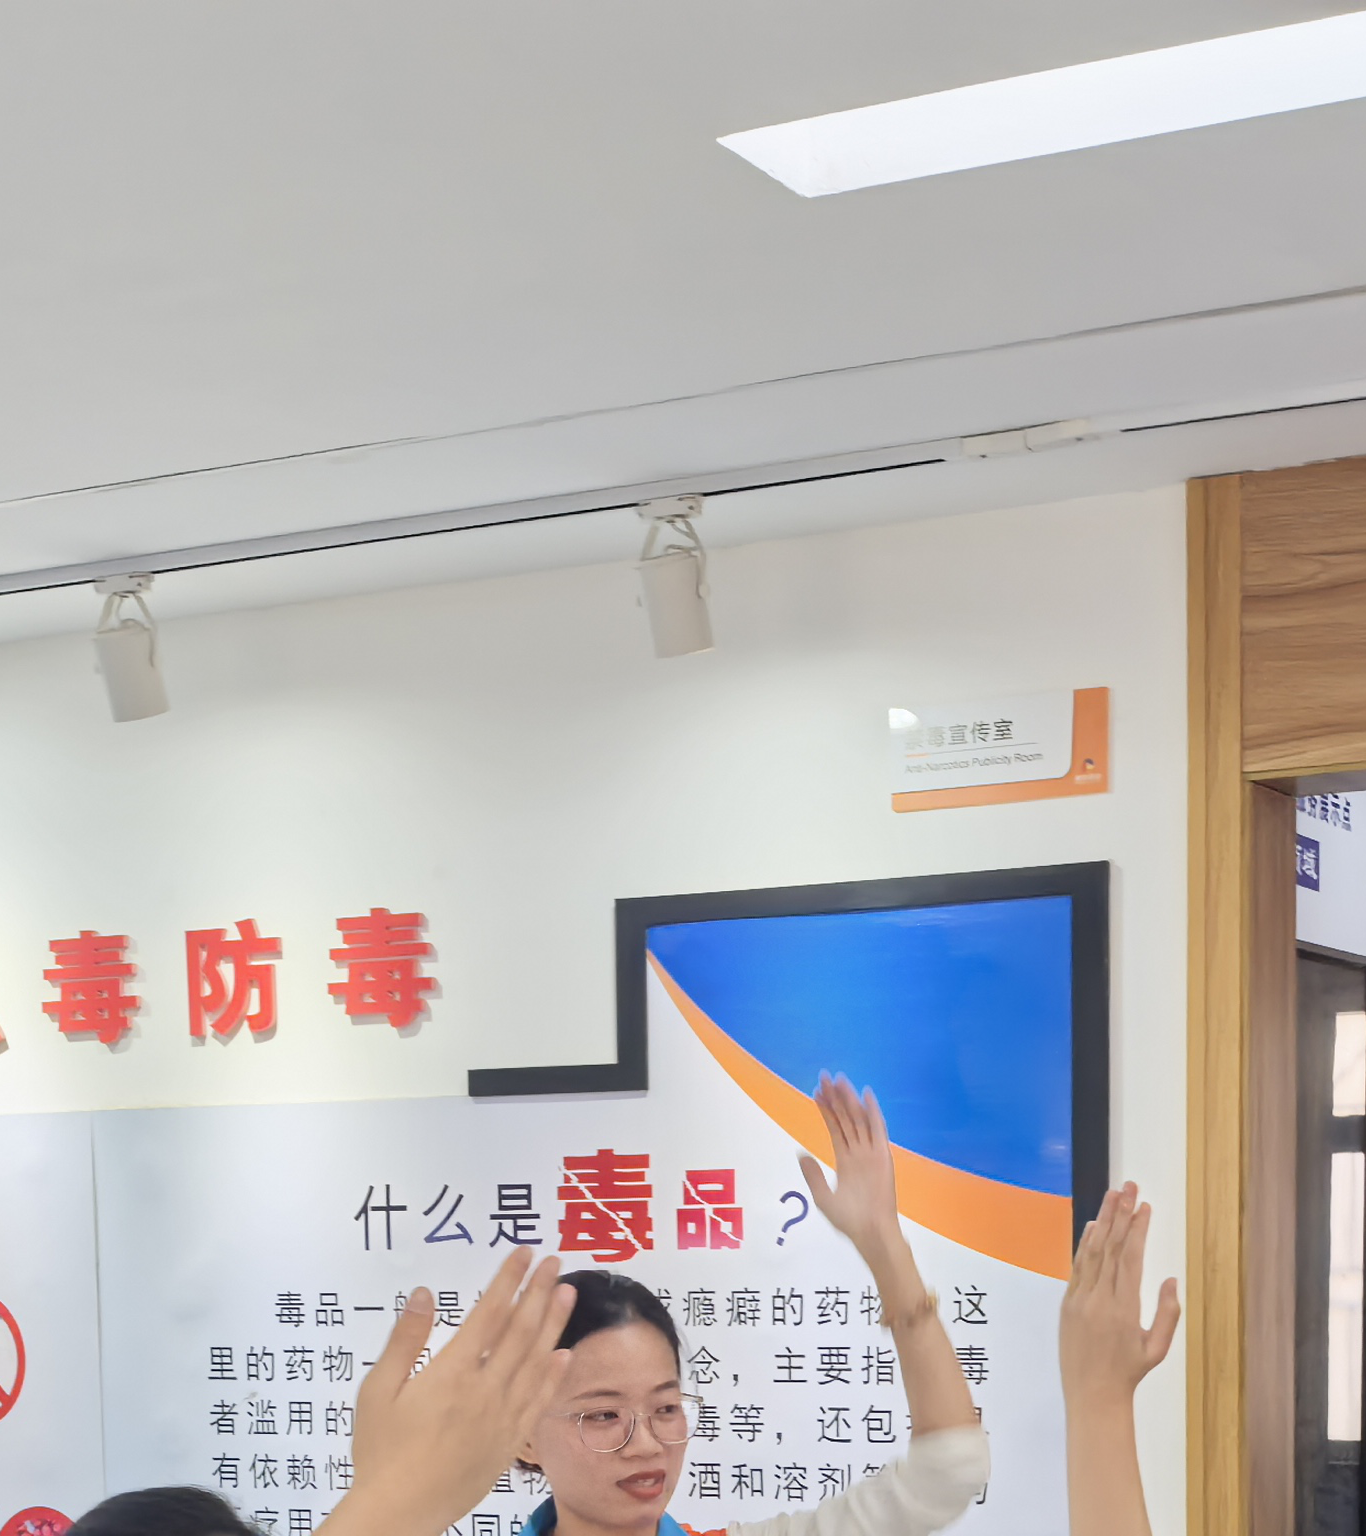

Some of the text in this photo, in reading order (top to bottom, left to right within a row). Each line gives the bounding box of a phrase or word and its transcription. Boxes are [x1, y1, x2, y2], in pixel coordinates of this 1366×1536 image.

[1014, 752, 1044, 763] Room
[275, 1291, 482, 1328] 毒品一是
[953, 1285, 989, 1326] 这
